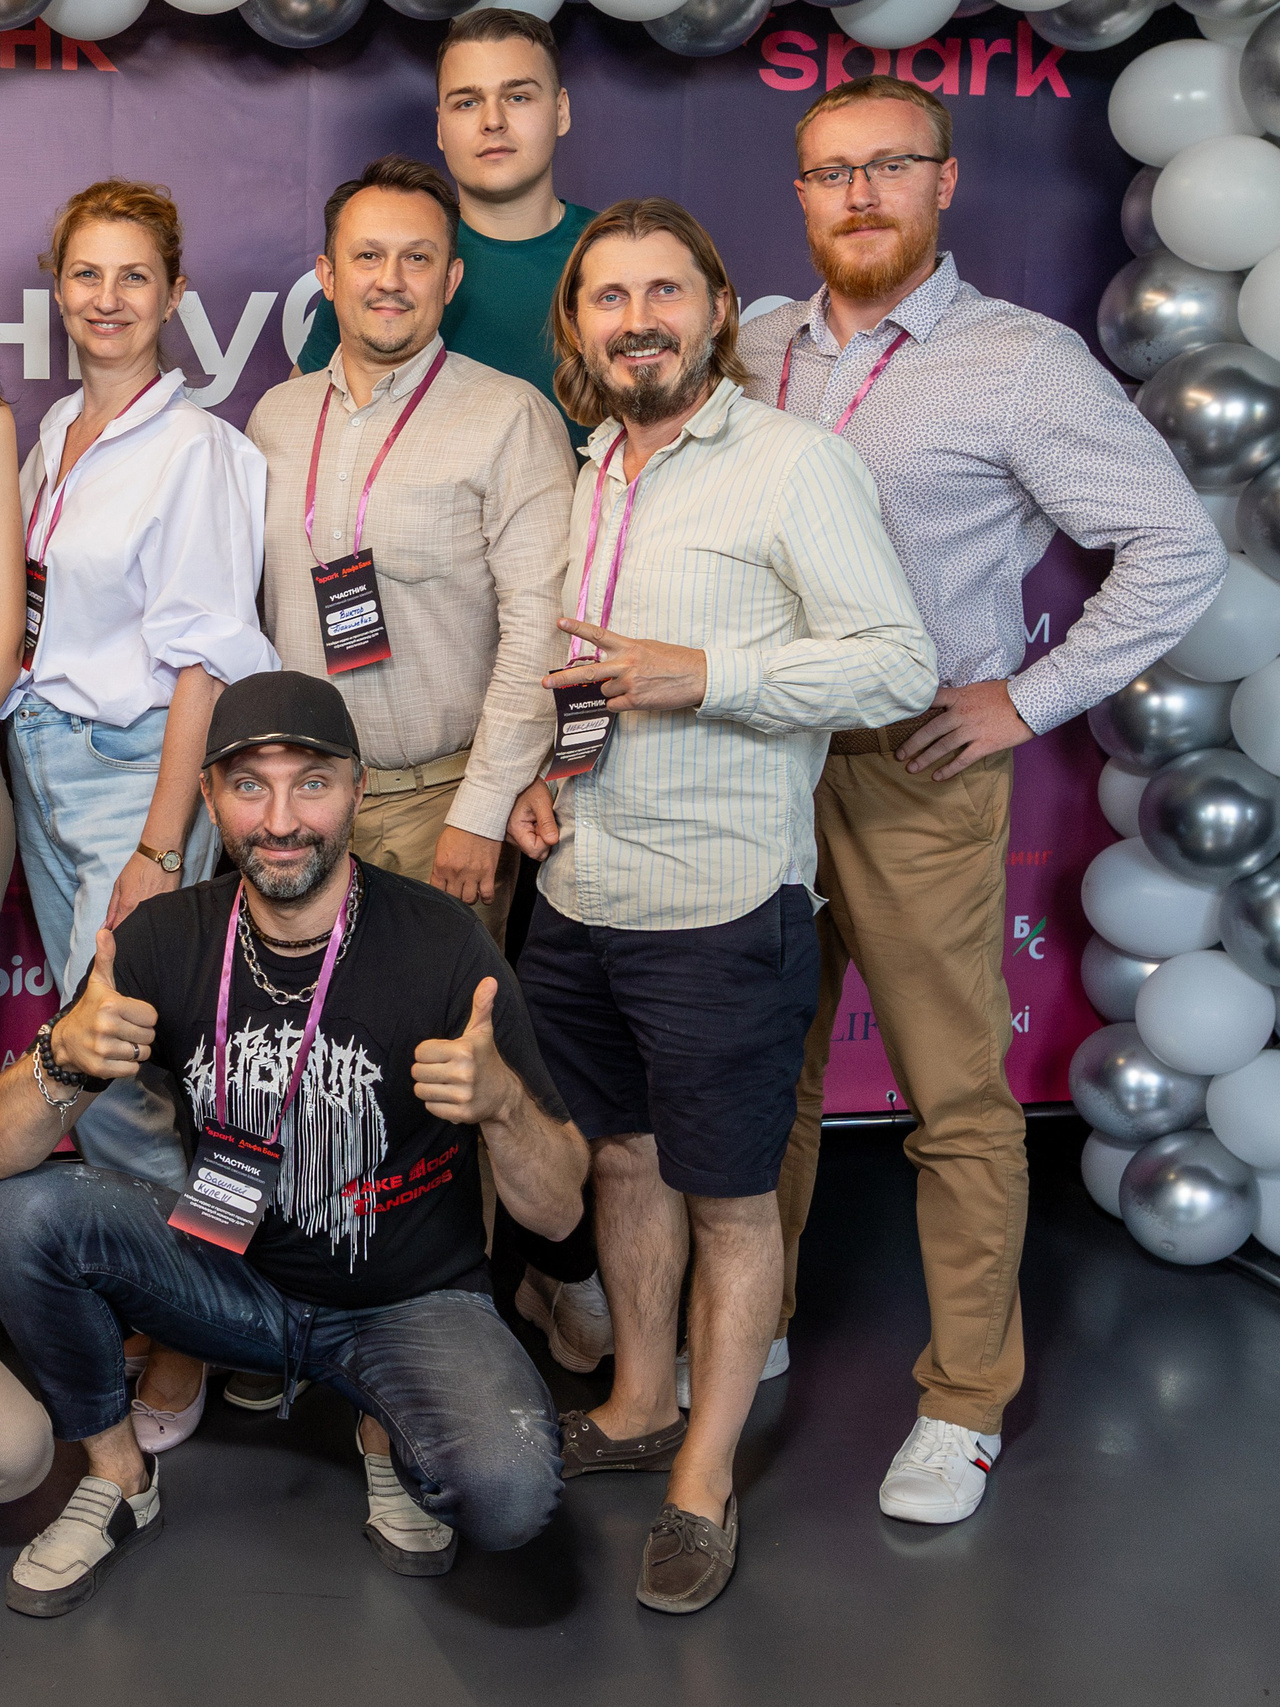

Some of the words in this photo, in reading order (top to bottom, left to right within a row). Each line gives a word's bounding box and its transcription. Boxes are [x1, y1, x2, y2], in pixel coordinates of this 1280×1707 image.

[758, 20, 1072, 98] spark
[329, 584, 367, 602] УЧАСТНИК
[569, 699, 606, 711] УЧАСТНИК
[207, 1129, 235, 1143] spark
[238, 1139, 261, 1153] Альфа
[262, 1147, 280, 1160] Банк
[213, 1152, 261, 1177] УЧАСТНИК
